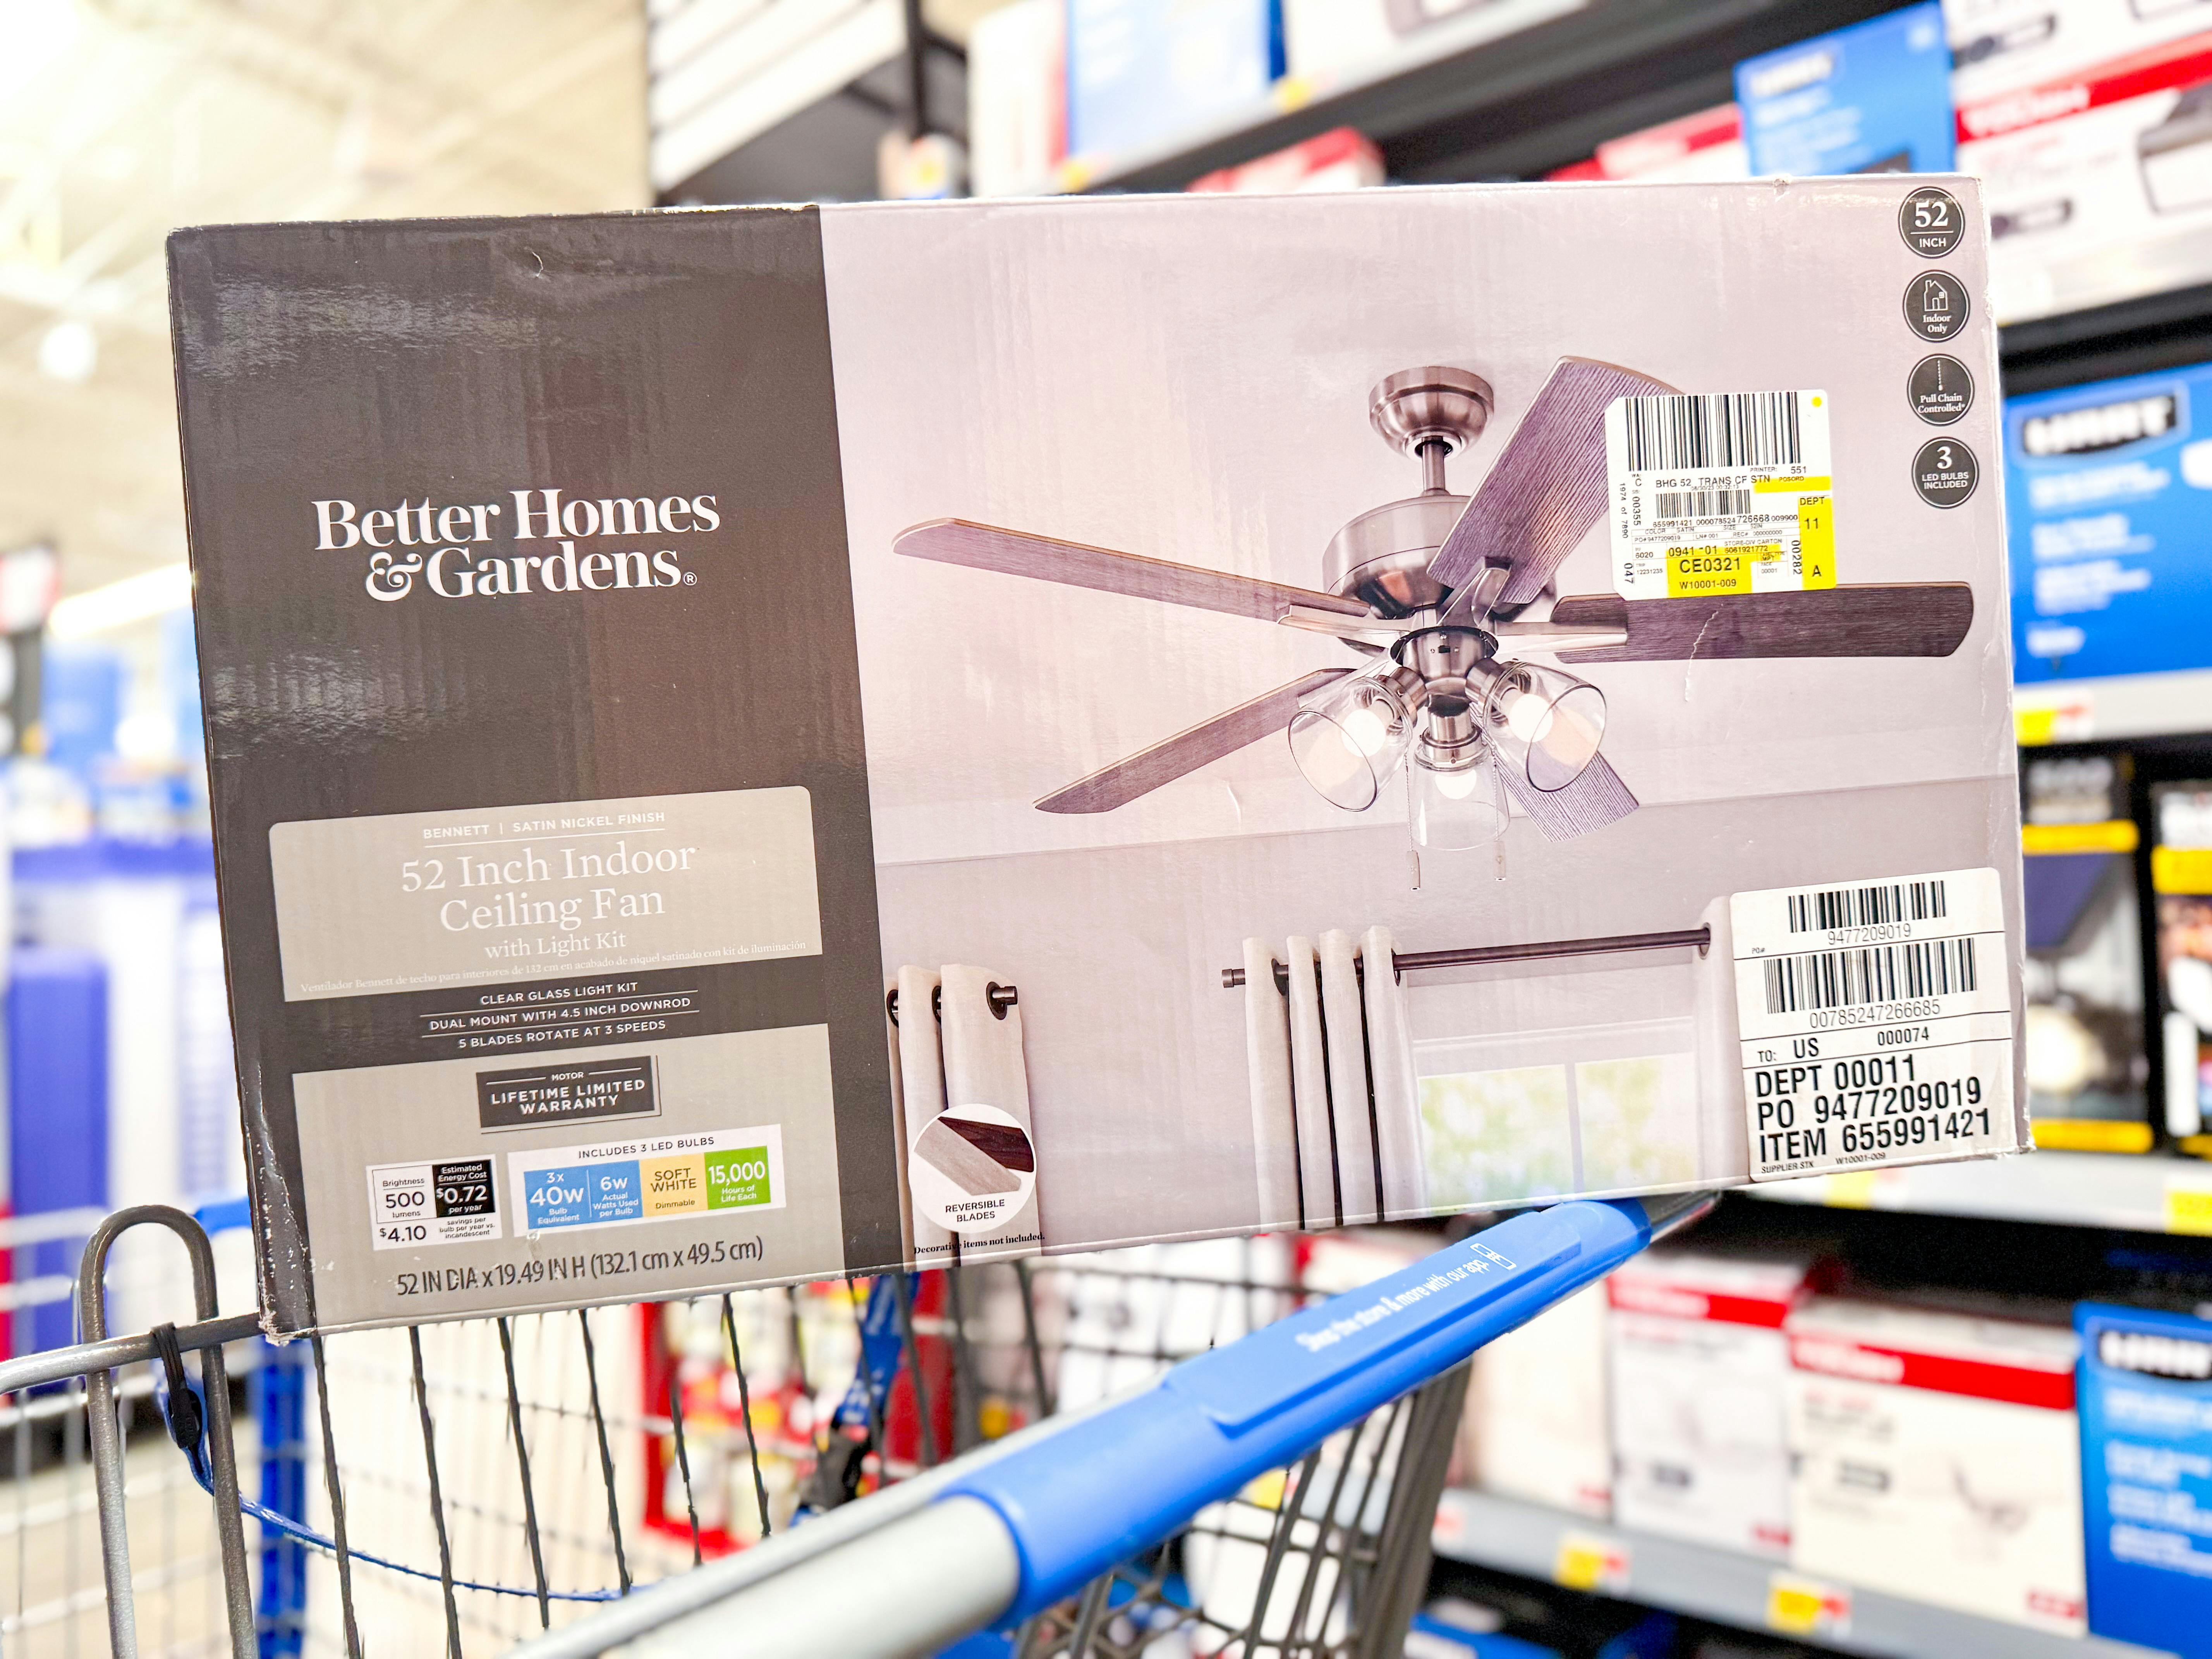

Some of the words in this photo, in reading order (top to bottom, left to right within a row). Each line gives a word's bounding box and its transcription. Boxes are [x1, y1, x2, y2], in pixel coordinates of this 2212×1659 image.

[1915, 200, 1948, 227] 52
[1920, 238, 1946, 248] INCH
[1923, 314, 1951, 323] Indoor
[1927, 325, 1947, 333] Only
[1920, 394, 1936, 403] Pull
[1938, 393, 1962, 402] Chain
[1937, 446, 1952, 469] 3
[1656, 479, 1677, 488] BHG
[1680, 479, 1691, 487] 52
[1698, 476, 1731, 486] TRANS
[1735, 476, 1747, 484] CF
[1751, 475, 1770, 483] STN
[1922, 473, 1939, 481] LED
[1941, 472, 1968, 481] BULBS
[1924, 480, 1968, 489] INCLUDED
[1800, 497, 1825, 505] DEPT
[311, 497, 500, 551] Better
[509, 488, 720, 539] Homes
[1632, 496, 1641, 526] 00355
[1737, 514, 1770, 523] 726668
[1804, 517, 1819, 529] 11
[1680, 557, 1740, 574] CE0321
[1791, 540, 1803, 575] 00282
[1812, 565, 1822, 577] A
[1679, 579, 1736, 589] W10001-009
[423, 824, 490, 839] BENNETT
[513, 819, 556, 833] SATIN
[561, 816, 613, 830] NICKEL
[618, 811, 666, 825] FINISH
[402, 859, 446, 893] 52
[458, 847, 551, 889] Inch
[560, 840, 696, 880] Indoor
[440, 891, 583, 931] Ceiling
[589, 886, 666, 920] Fan
[1827, 923, 1911, 945] 9477209019
[484, 938, 531, 959] with
[537, 933, 591, 958] Light
[594, 930, 627, 950] Kit
[300, 981, 353, 993] Ventilador
[356, 978, 393, 989] Bennett
[395, 975, 408, 985] de
[410, 973, 437, 984] techo
[439, 973, 460, 983] para
[462, 967, 510, 979] interiores
[511, 964, 524, 975] de
[526, 964, 542, 974] 132
[575, 957, 615, 969] acabado
[662, 949, 702, 962] satinado
[704, 949, 721, 958] con
[723, 946, 736, 956] kit
[737, 945, 749, 955] de
[751, 940, 806, 954] iluminación
[481, 993, 524, 1006] CLEAR
[528, 989, 571, 1002] GLASS
[575, 984, 613, 997] LIGHT
[618, 982, 638, 993] KIT
[430, 1018, 466, 1030] DUAL
[470, 1013, 517, 1027] MOUNT
[522, 1010, 556, 1022] WITH
[560, 1007, 581, 1019] 4.5
[584, 1005, 617, 1017] INCH
[621, 998, 691, 1013] DOWNROD
[1810, 999, 1941, 1029] 00785247266685
[458, 1038, 467, 1048] 5
[471, 1034, 522, 1047] BLADES
[527, 1029, 580, 1042] ROTATE
[584, 1027, 601, 1037] AT
[605, 1025, 613, 1035] 3
[617, 1020, 666, 1034] SPEEDS
[1757, 1050, 1777, 1062] TO:
[1793, 1037, 1820, 1059] US
[1877, 1026, 1930, 1046] 000074
[551, 1071, 584, 1081] MOTOR
[1755, 1065, 1822, 1097] DEPT
[1834, 1054, 1915, 1091] 00011
[491, 1087, 570, 1105] LIFETIME
[576, 1079, 645, 1096] LIMITED
[520, 1094, 619, 1115] WARRANTY
[1757, 1099, 1794, 1130] PO
[1814, 1076, 1982, 1124] 9477209019
[1759, 1128, 1827, 1163] ITEM
[1842, 1108, 1991, 1153] 655991421
[579, 1145, 637, 1159] INCLUDES
[641, 1144, 647, 1152] 3
[651, 1141, 673, 1151] LED
[678, 1137, 715, 1148] BULBS
[438, 1172, 467, 1182] Energy
[469, 1171, 487, 1179] Cost
[442, 1163, 483, 1174] Estimated
[654, 1168, 691, 1182] SOFT
[708, 1161, 766, 1186] 15,000
[1761, 1162, 1798, 1174] SUPPLIER
[383, 1178, 425, 1187] Brightness
[601, 1176, 628, 1190] 6w
[651, 1178, 697, 1193] WHITE
[386, 1191, 425, 1209] 500
[436, 1185, 488, 1204] $0.72
[529, 1186, 584, 1206] 40w
[602, 1192, 628, 1201] Actual
[721, 1194, 736, 1203] Life
[464, 1204, 482, 1213] year
[593, 1200, 617, 1210] Watts
[619, 1198, 639, 1207] Used
[656, 1199, 696, 1209] Dimmable
[945, 1199, 1005, 1213] REVERSIBLE
[538, 1214, 580, 1225] Equivalent
[957, 1211, 996, 1222] BLADES
[380, 1225, 427, 1242] $4.10
[445, 1230, 490, 1239] incandescent
[914, 1240, 962, 1254] Decorative
[963, 1238, 988, 1249] items
[989, 1237, 1004, 1245] not
[1006, 1232, 1045, 1243] included.
[397, 1273, 419, 1296] 52
[422, 1271, 442, 1293] IN
[446, 1268, 478, 1290] DIA
[483, 1273, 493, 1286] x
[497, 1260, 543, 1286] 19.49
[548, 1259, 568, 1280] IN
[573, 1256, 584, 1277] H
[591, 1250, 637, 1280] (132.1
[642, 1252, 670, 1271] cm
[673, 1249, 683, 1267] x
[688, 1240, 726, 1265] 49.5
[729, 1235, 763, 1261] cm)
[1380, 1296, 1404, 1312] &
[1395, 1285, 1431, 1307] more
[1422, 1274, 1453, 1292] with
[1446, 1266, 1469, 1281] our
